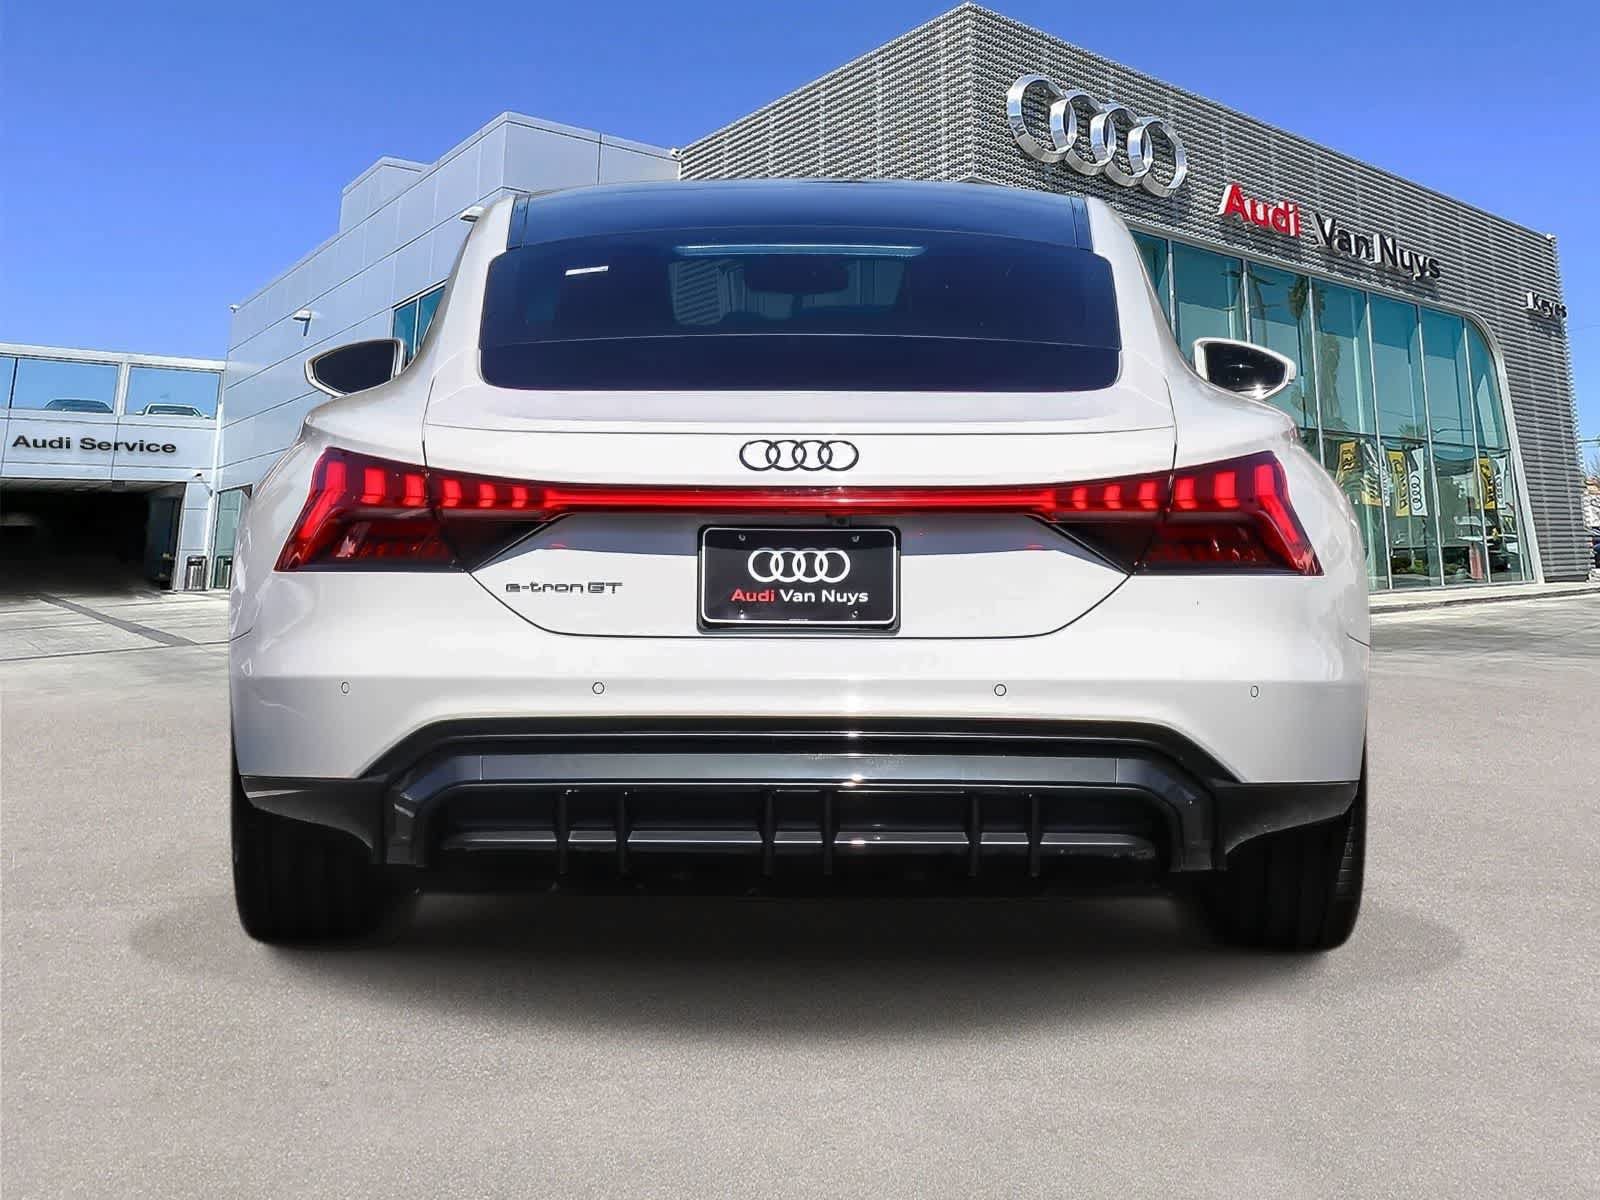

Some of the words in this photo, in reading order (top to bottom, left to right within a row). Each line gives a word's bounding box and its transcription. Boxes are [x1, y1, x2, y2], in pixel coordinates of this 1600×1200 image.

[1218, 183, 1301, 238] Audi
[1311, 212, 1374, 262] Van
[1373, 231, 1441, 280] Nuys
[1527, 291, 1568, 320] Keyes
[12, 434, 71, 449] Audi
[79, 437, 177, 453] Service
[731, 588, 775, 602] Audi
[779, 589, 816, 602] Van
[821, 589, 869, 606] Nuys
